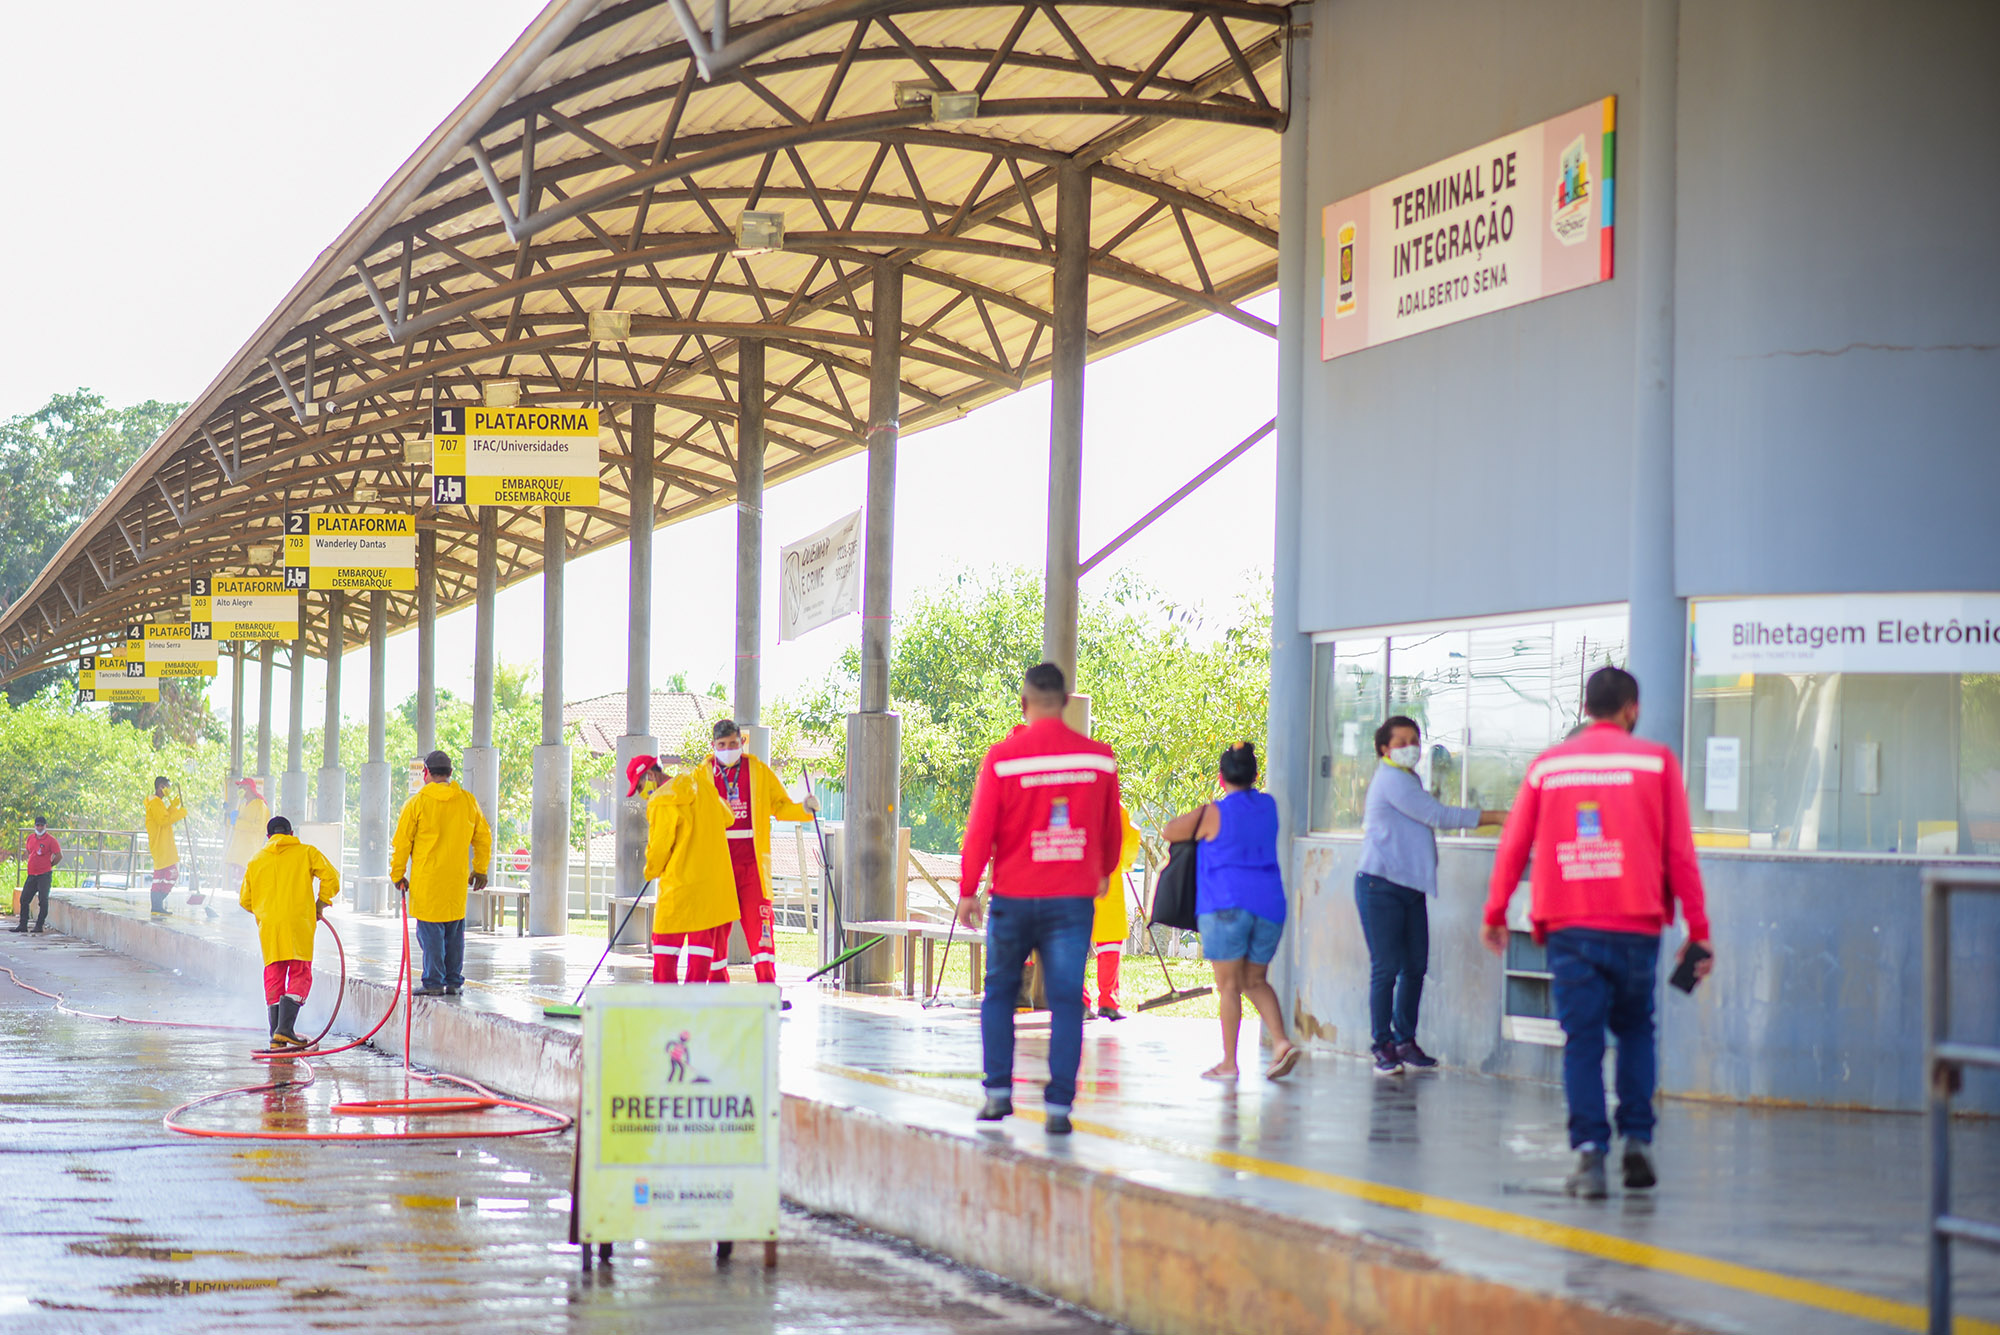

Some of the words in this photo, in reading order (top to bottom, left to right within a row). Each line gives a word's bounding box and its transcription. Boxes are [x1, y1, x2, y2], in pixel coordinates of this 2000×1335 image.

[1392, 164, 1484, 230] TERMINAL
[1492, 151, 1517, 194] DE
[1393, 200, 1514, 279] INTEGRAÇÃO
[1397, 275, 1469, 319] ADALBERTO
[1473, 263, 1508, 298] SENA
[441, 410, 457, 432] 1
[475, 413, 589, 430] PLATAFORMA
[440, 439, 458, 451] 707
[473, 440, 569, 452] IFAC/Universidades
[502, 479, 564, 491] EMBARQUE/
[495, 491, 571, 504] DESEMBARQUE
[290, 515, 303, 533] 2
[317, 518, 407, 531] PLATAFORMA
[290, 538, 304, 547] 703
[316, 539, 358, 551] Wanderley
[360, 539, 387, 548] Dantas
[337, 569, 387, 579] EMBARQUE/
[195, 579, 206, 595] 3
[217, 581, 292, 592] PLATAFORM
[332, 578, 393, 589] DESEMBARQUE
[231, 599, 253, 608] Alegre
[130, 626, 140, 639] 4
[150, 627, 191, 637] PLATAFO
[234, 623, 275, 631] EMBARQUE/
[230, 631, 280, 639] DESEMBARQUE
[1732, 622, 1866, 649] Bilhetagem
[83, 658, 91, 669] 5
[99, 660, 127, 668] PLATA
[165, 662, 199, 670] EMBARQUE/
[611, 1096, 755, 1119] PREFEITURA
